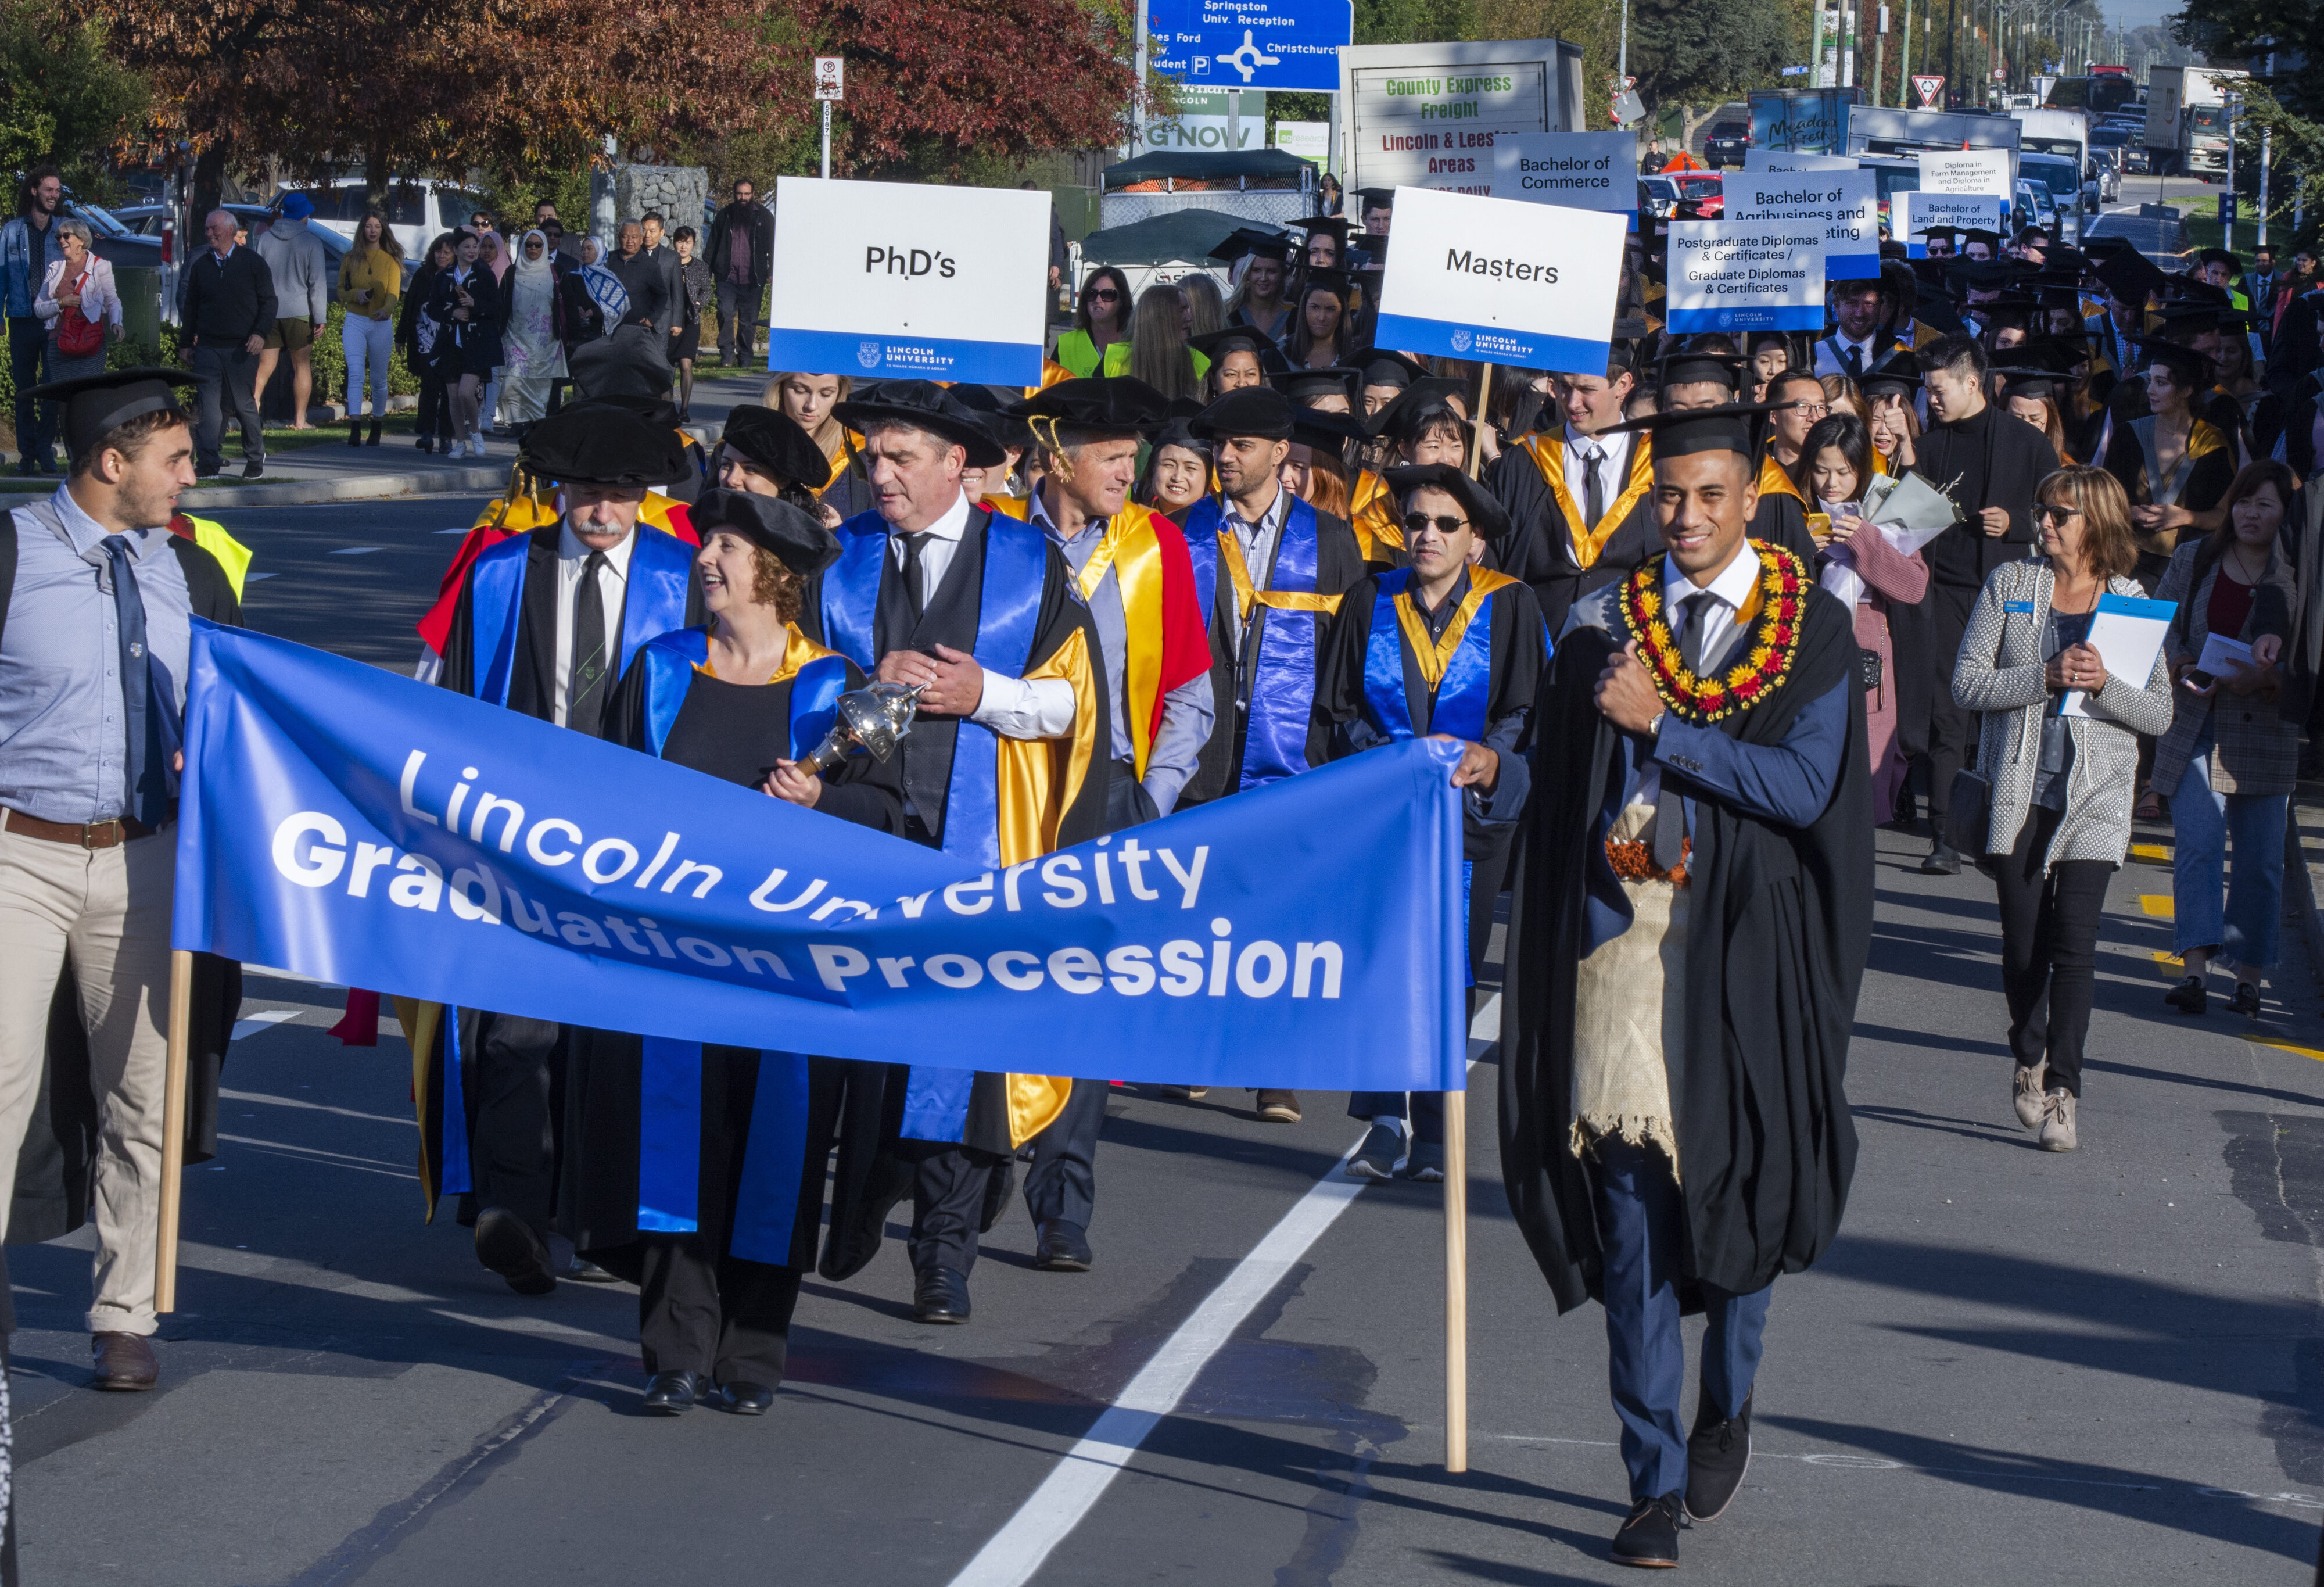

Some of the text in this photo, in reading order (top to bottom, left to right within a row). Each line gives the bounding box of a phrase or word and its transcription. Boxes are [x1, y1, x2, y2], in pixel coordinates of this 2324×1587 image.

[1204, 1, 1267, 13] Springston
[1203, 14, 1295, 27] Univ. Reception
[1177, 33, 1201, 43] Ford
[1149, 59, 1186, 69] udent
[1386, 77, 1511, 96] County Express
[1421, 101, 1479, 119] Freight
[1281, 134, 1327, 143] agresearch
[1383, 130, 1519, 151] Lincoln & Lees
[1429, 157, 1475, 173] Areas
[1520, 156, 1610, 171] Bachelor of
[1521, 176, 1610, 189] Commerce
[1945, 185, 1984, 194] Agriculture
[1756, 188, 1842, 205] Bachelor of
[1837, 206, 1865, 220] and
[1928, 204, 1968, 213] Bachelor
[1913, 215, 1996, 226] Land and Property
[1678, 235, 1819, 249] Postgraduate Diplomas
[1702, 249, 1793, 261] & Certificates /
[866, 246, 956, 278] PhD's
[1446, 248, 1559, 284] Masters
[1688, 268, 1805, 281] Graduate Diplomas
[1705, 282, 1788, 294] & Certificates
[1476, 334, 1516, 345] LINCOLN
[887, 346, 934, 355] LINCOLN
[1476, 341, 1533, 353] UNIVERSITY
[887, 354, 954, 364] UNIVERSITY
[400, 748, 723, 900] Lincoln
[749, 834, 1210, 923] Unversity
[271, 810, 795, 982] Graduation
[808, 917, 1343, 1000] Procession
